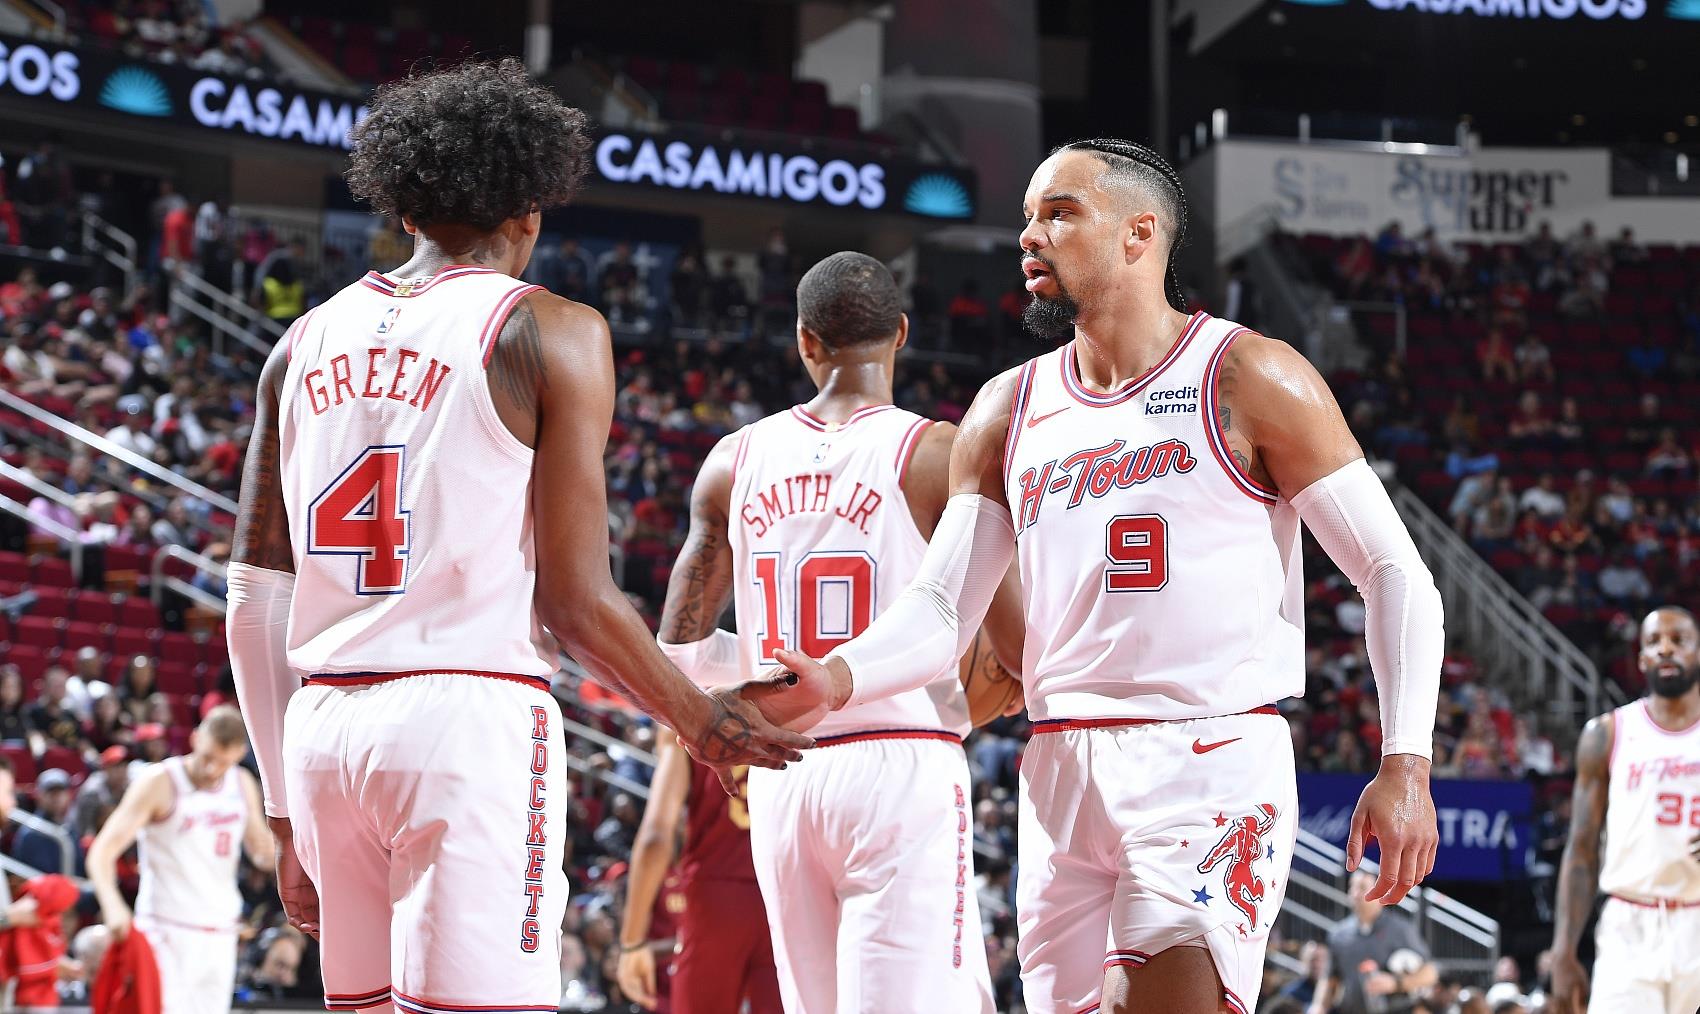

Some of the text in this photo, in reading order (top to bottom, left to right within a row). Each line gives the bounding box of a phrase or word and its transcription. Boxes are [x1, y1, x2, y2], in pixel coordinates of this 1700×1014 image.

[0, 42, 80, 101] OS
[190, 77, 369, 150] CASAM
[596, 134, 886, 208] CASAMIGOS
[304, 348, 451, 416] GREEN
[1145, 402, 1197, 415] karma
[1150, 386, 1198, 401] credit
[307, 444, 412, 595] 4
[741, 474, 883, 538] SMITH JR.
[1016, 438, 1197, 537] H-Town
[1106, 513, 1169, 593] 9
[752, 551, 877, 666] 10
[521, 705, 549, 953] ROCKETS
[1437, 808, 1518, 848] TRA
